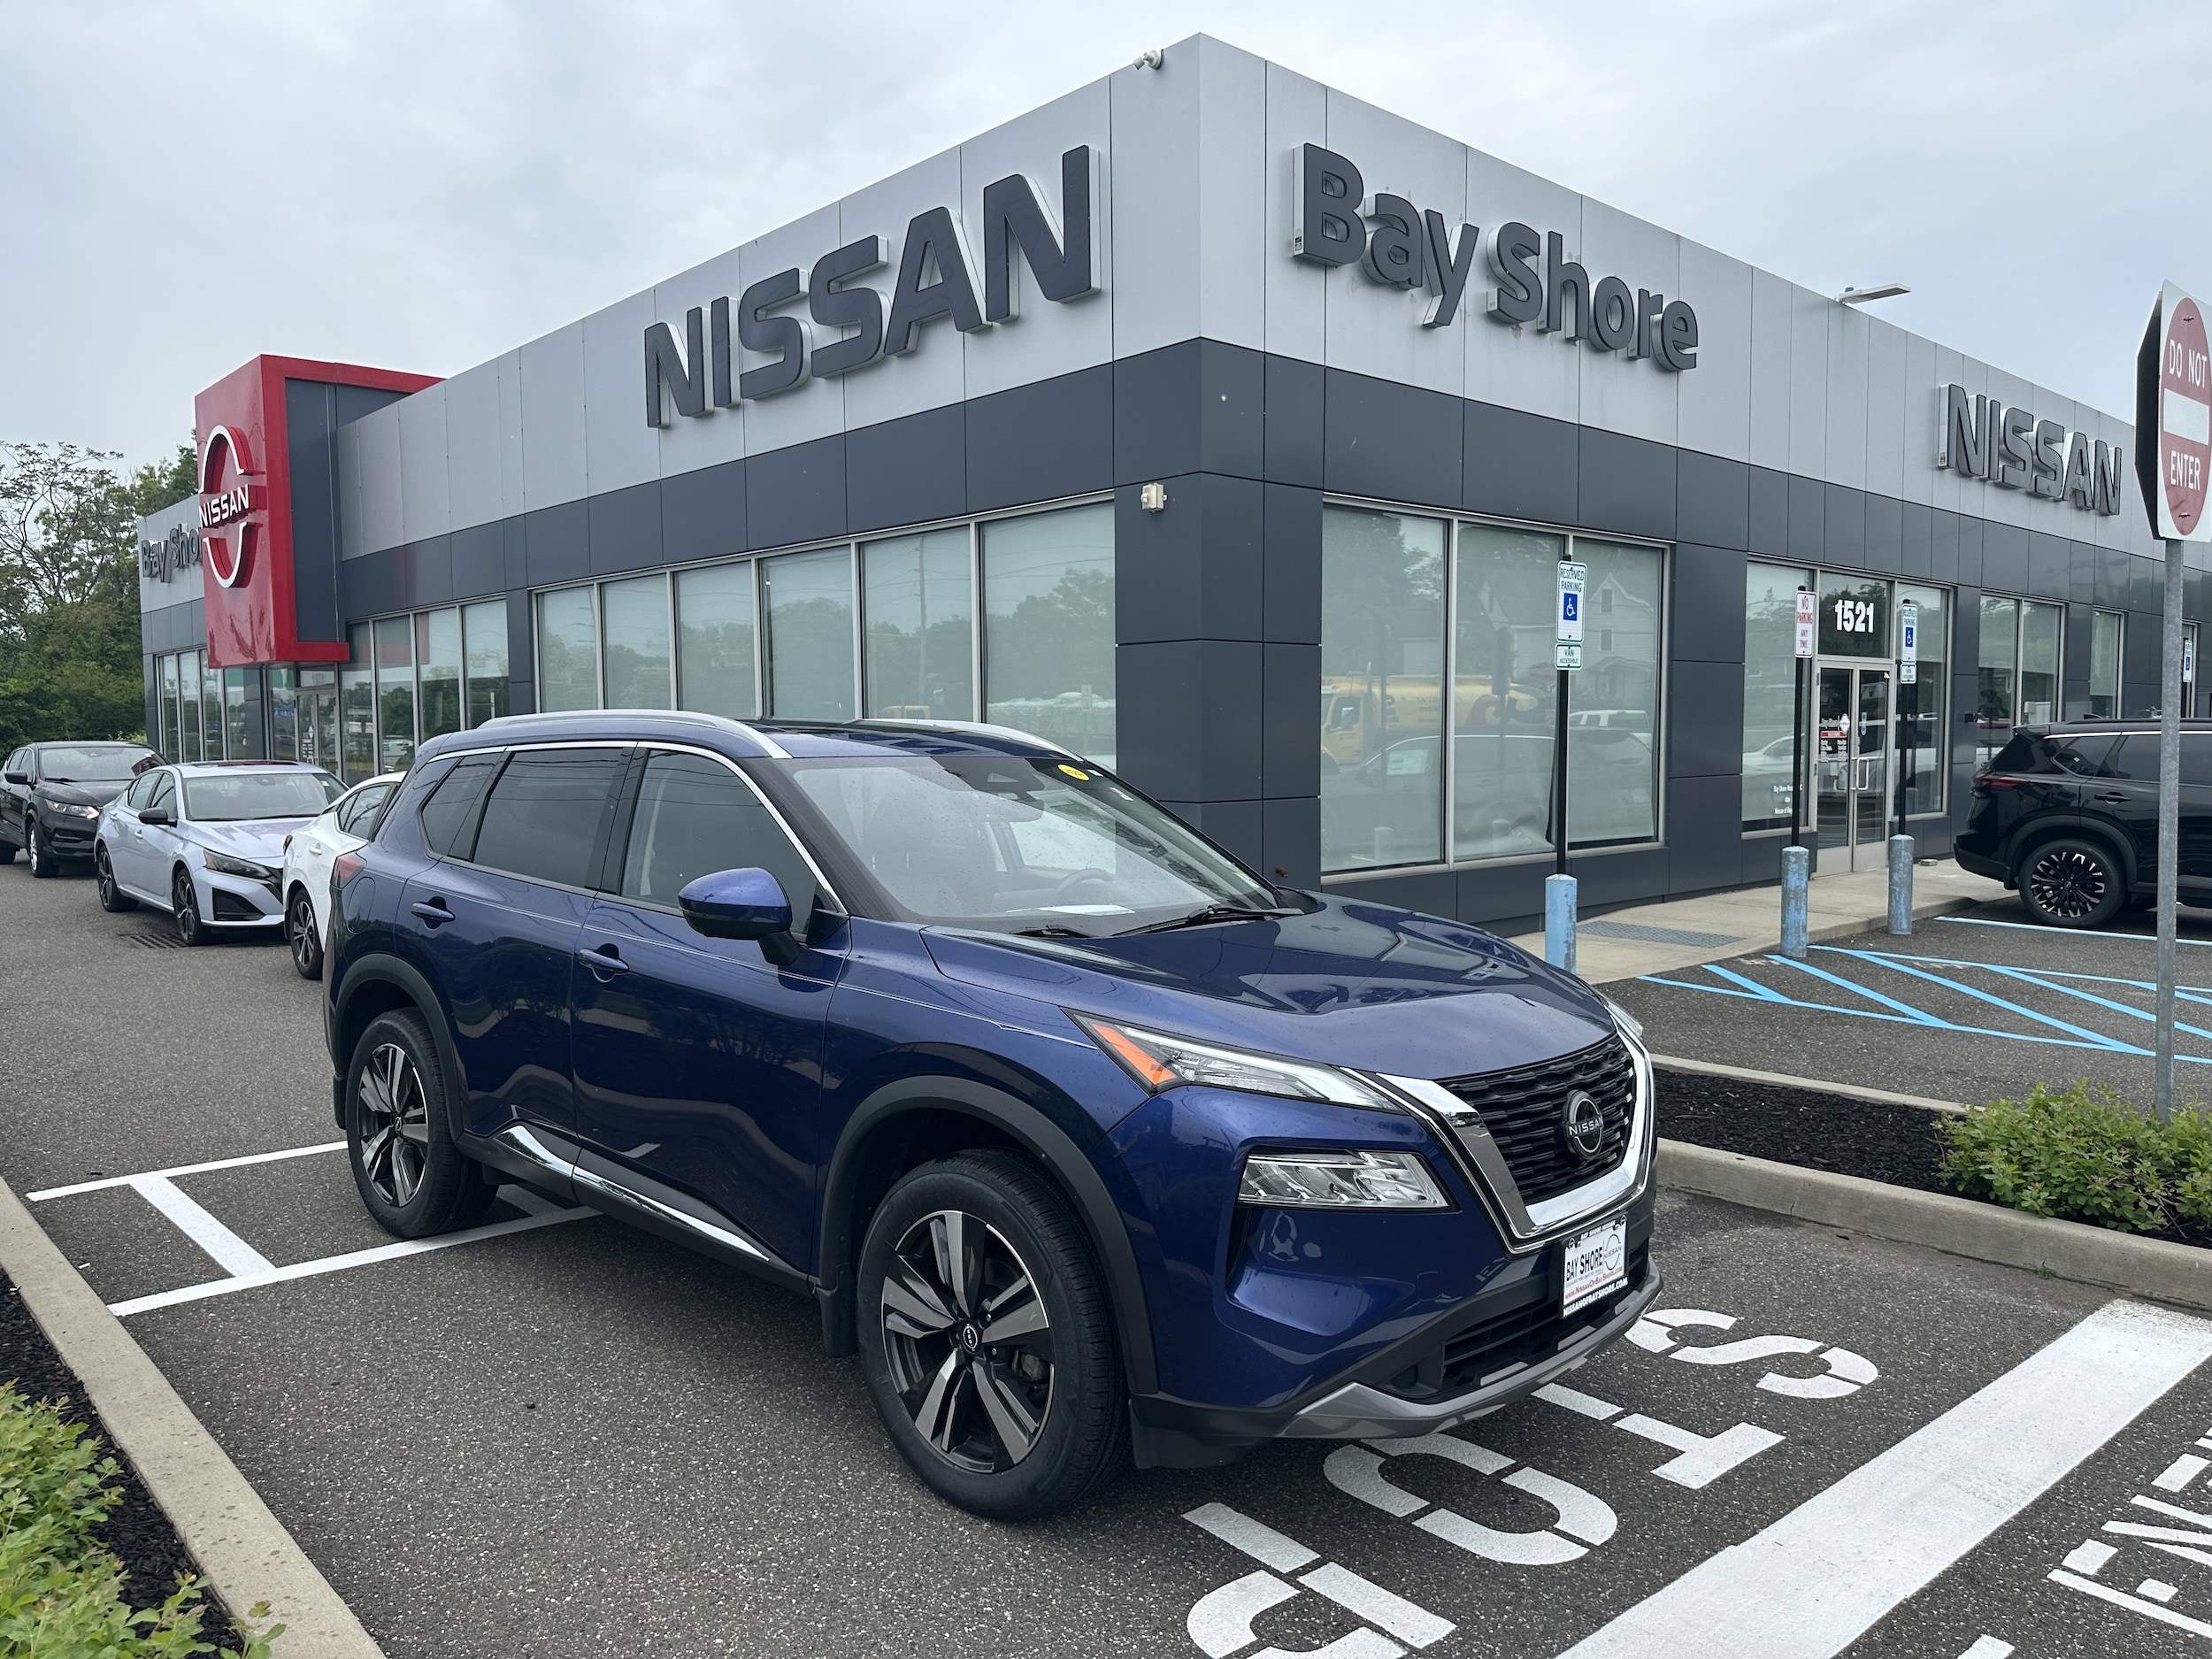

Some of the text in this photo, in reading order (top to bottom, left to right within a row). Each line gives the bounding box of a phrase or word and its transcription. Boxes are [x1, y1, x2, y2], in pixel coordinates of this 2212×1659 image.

[1293, 142, 1698, 373] Bay Shore
[644, 144, 1101, 428] NISSAN
[2169, 339, 2208, 388] DO NOT
[1938, 383, 2123, 516] NISSAN
[2170, 450, 2200, 491] ENTER
[198, 484, 249, 528] NISSAN
[142, 523, 203, 584] Bay Sho
[1560, 568, 1585, 580] RESERVED
[1561, 580, 1582, 592] PARKING
[1797, 612, 1813, 625] PARKING
[1801, 597, 1809, 611] NO
[1834, 599, 1875, 634] 1521
[1568, 1117, 1603, 1136] NISSAN
[1566, 1256, 1579, 1281] BAY
[1579, 1247, 1603, 1274] SHORE
[1603, 1246, 1622, 1258] NISSAN
[1563, 1277, 1628, 1317] NISSANOFBAYSHORE.COM
